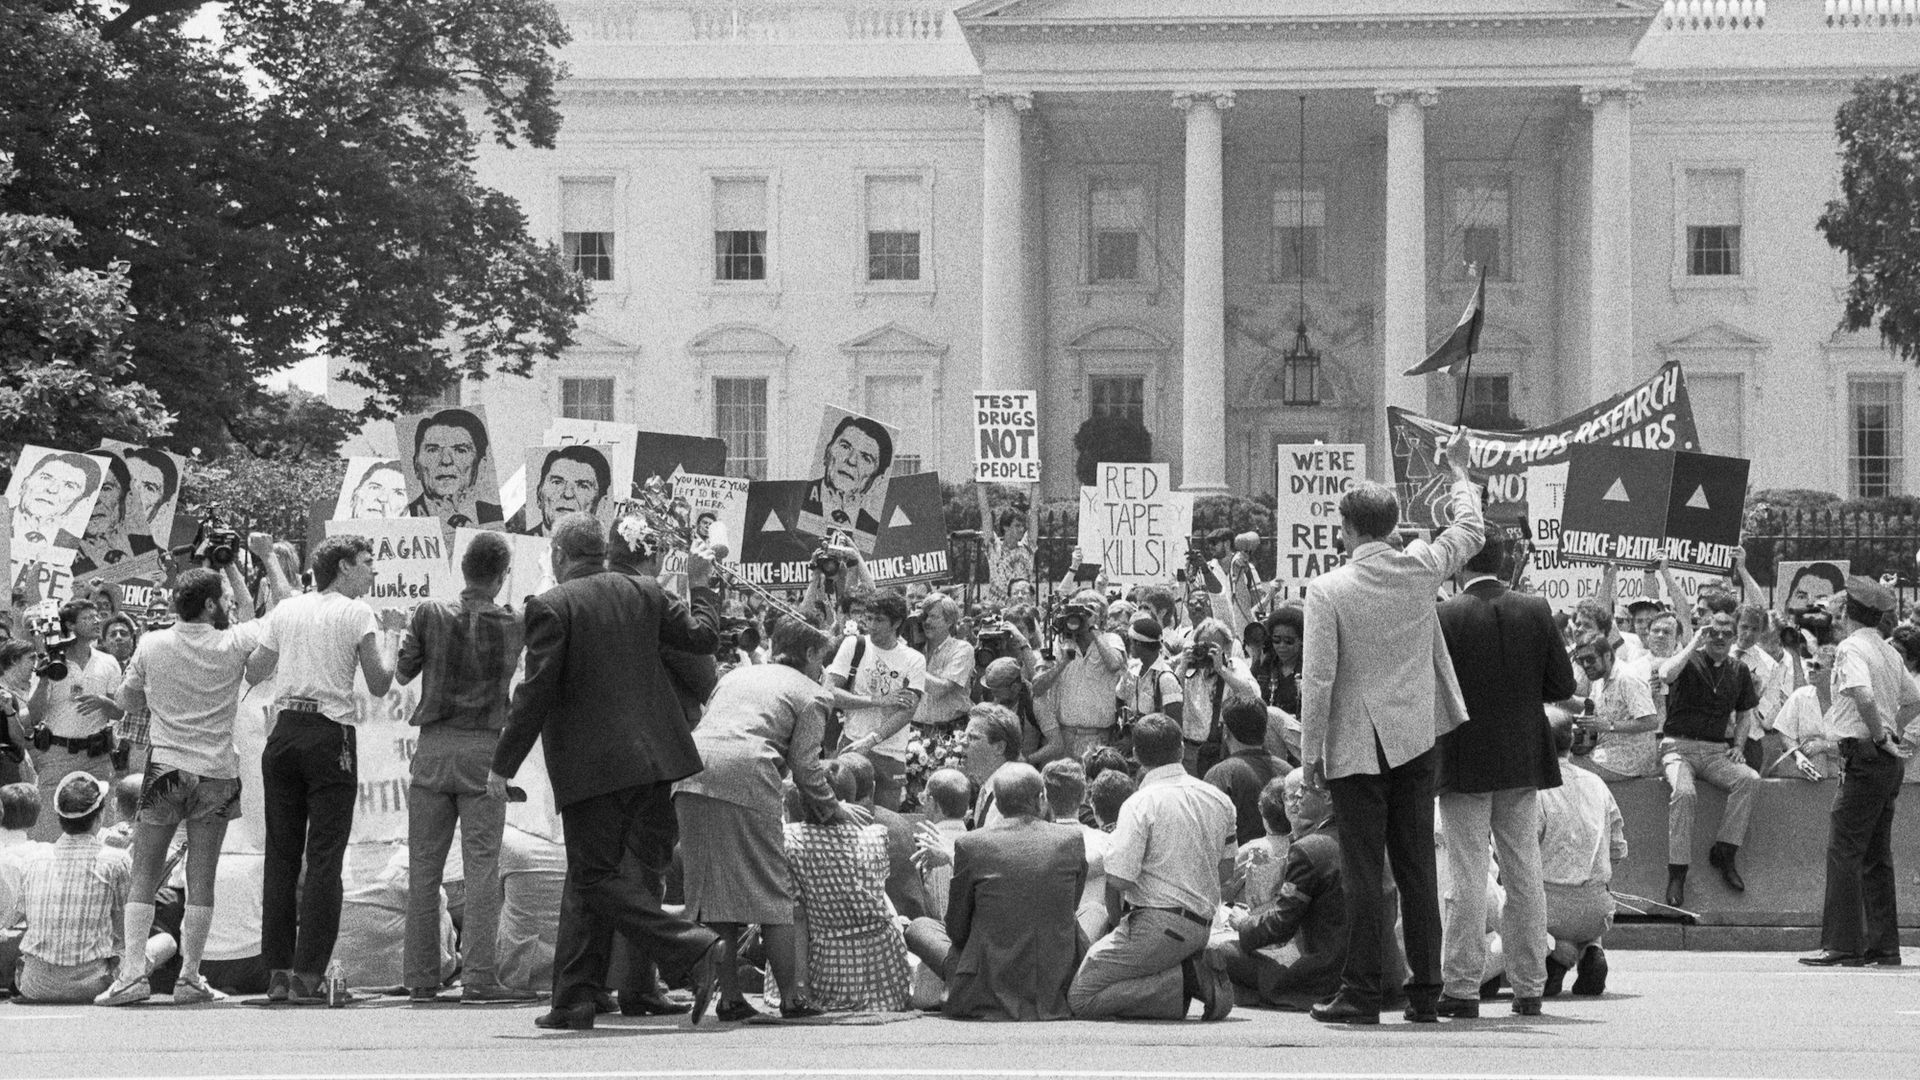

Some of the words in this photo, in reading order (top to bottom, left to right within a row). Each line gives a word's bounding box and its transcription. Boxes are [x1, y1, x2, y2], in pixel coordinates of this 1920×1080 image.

[975, 395, 1029, 410] TEST
[978, 410, 1035, 427] DRUGS
[1434, 435, 1507, 469] FND
[1506, 430, 1573, 466] AIDS
[1574, 366, 1679, 443] RESEARCH
[980, 428, 1035, 459] NOT
[980, 462, 1036, 479] PEOPLE
[1291, 451, 1355, 471] WE'RE
[674, 475, 692, 486] YOU
[695, 477, 717, 488] HAVE
[1106, 466, 1158, 500] RED
[1290, 474, 1355, 496] DYING
[1487, 472, 1528, 504] NO
[724, 490, 734, 500] A
[1103, 503, 1164, 537] TAPE
[1310, 501, 1336, 518] OF
[377, 535, 441, 561] AGAN
[1103, 538, 1166, 577] KILLS!
[1560, 529, 1659, 560] SILENCE=DEATH
[1665, 536, 1733, 568] ENCE=DEATH
[371, 572, 430, 598] lunked
